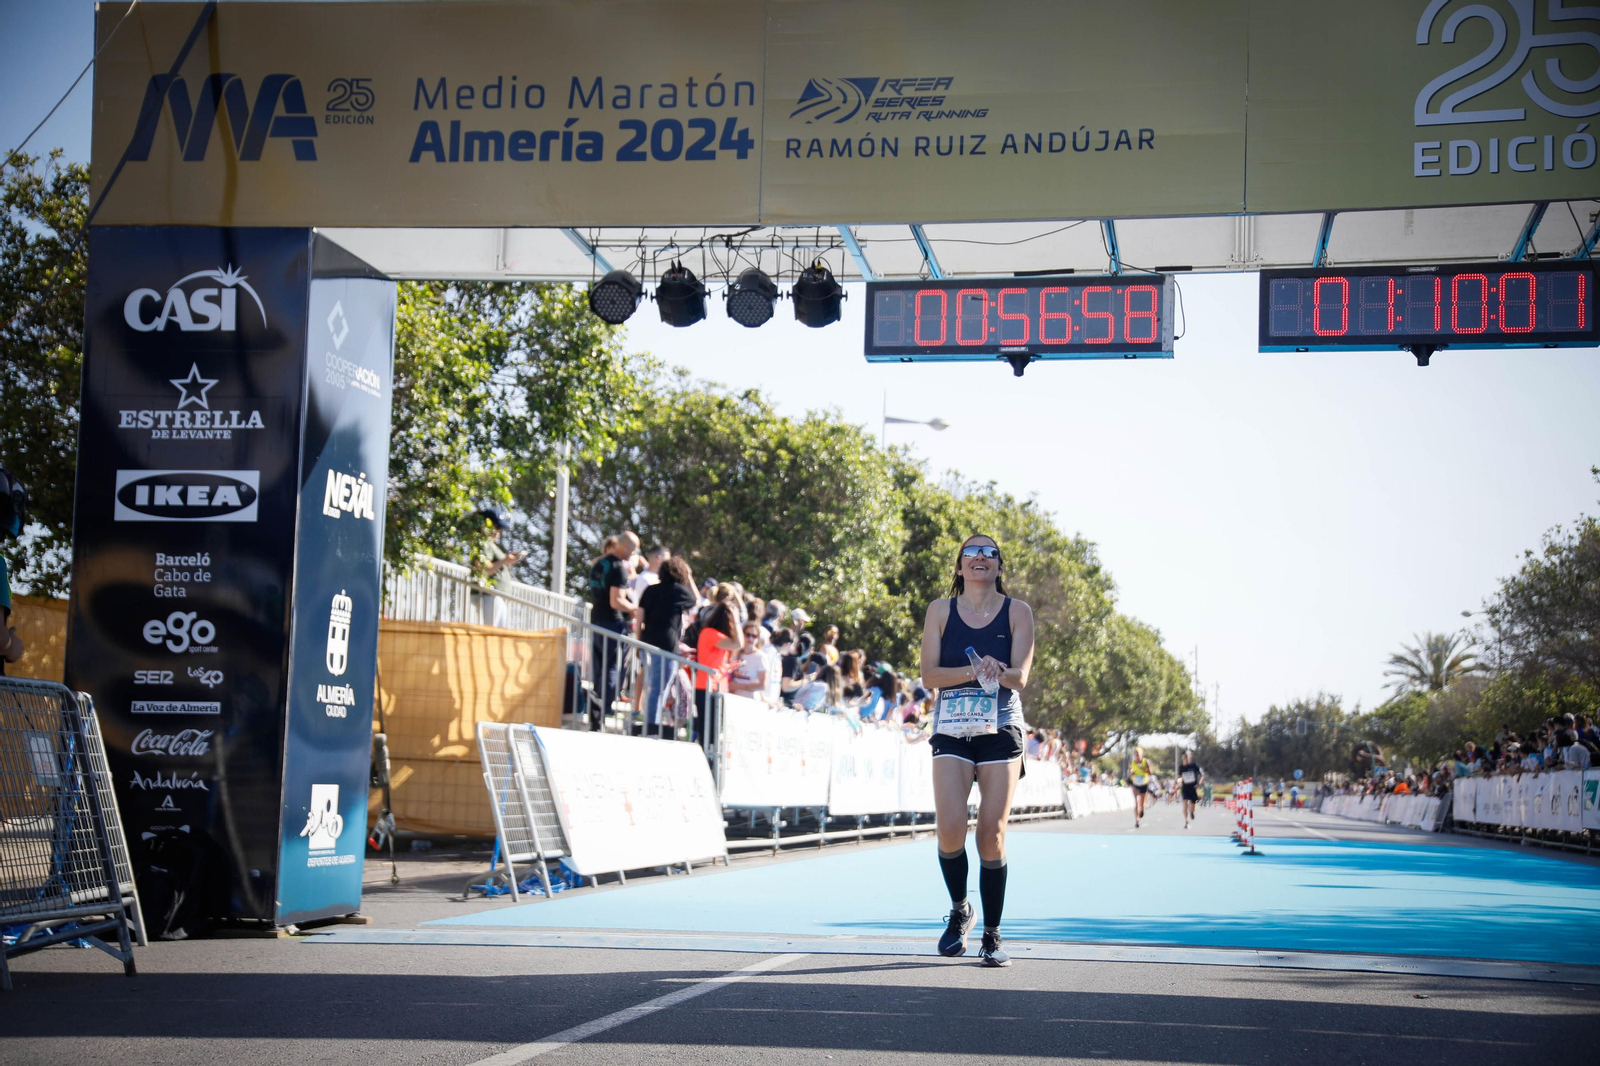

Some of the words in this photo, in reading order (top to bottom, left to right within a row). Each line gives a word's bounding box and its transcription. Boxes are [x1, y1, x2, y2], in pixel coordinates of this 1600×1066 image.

[326, 78, 375, 112] 25
[413, 75, 546, 110] Medio
[568, 73, 755, 109] Maratón
[872, 95, 946, 109] SERIES
[325, 112, 375, 125] EDICIÓN
[865, 111, 911, 123] RUTA
[916, 108, 989, 121] RUNNING
[409, 118, 604, 163] Almería
[616, 117, 755, 162] 2024
[785, 132, 899, 159] RAMÓN
[914, 134, 987, 157] RUIZ
[1000, 125, 1155, 155] ANDÚJAR
[123, 287, 237, 332] CASI
[325, 351, 381, 391] COOPERACIÓN
[325, 367, 346, 390] 2005
[118, 410, 265, 429] ESTRELLA
[151, 430, 170, 439] DE
[172, 430, 231, 440] LEVANTE
[135, 485, 242, 506] IKEA
[155, 552, 211, 566] Barceló
[154, 568, 190, 582] Cabo
[194, 568, 212, 582] de
[153, 584, 187, 598] Gata
[143, 611, 216, 652] ego
[188, 645, 202, 654] sport
[134, 670, 174, 684] SER
[199, 670, 224, 689] 40
[316, 683, 356, 706] ALMERÍA
[132, 703, 146, 712] La
[147, 703, 165, 712] Voz
[166, 703, 178, 712] de
[179, 703, 218, 713] Almería
[325, 704, 347, 719] CIUDAD
[945, 696, 992, 714] 5179
[129, 770, 209, 791] Andalucía
